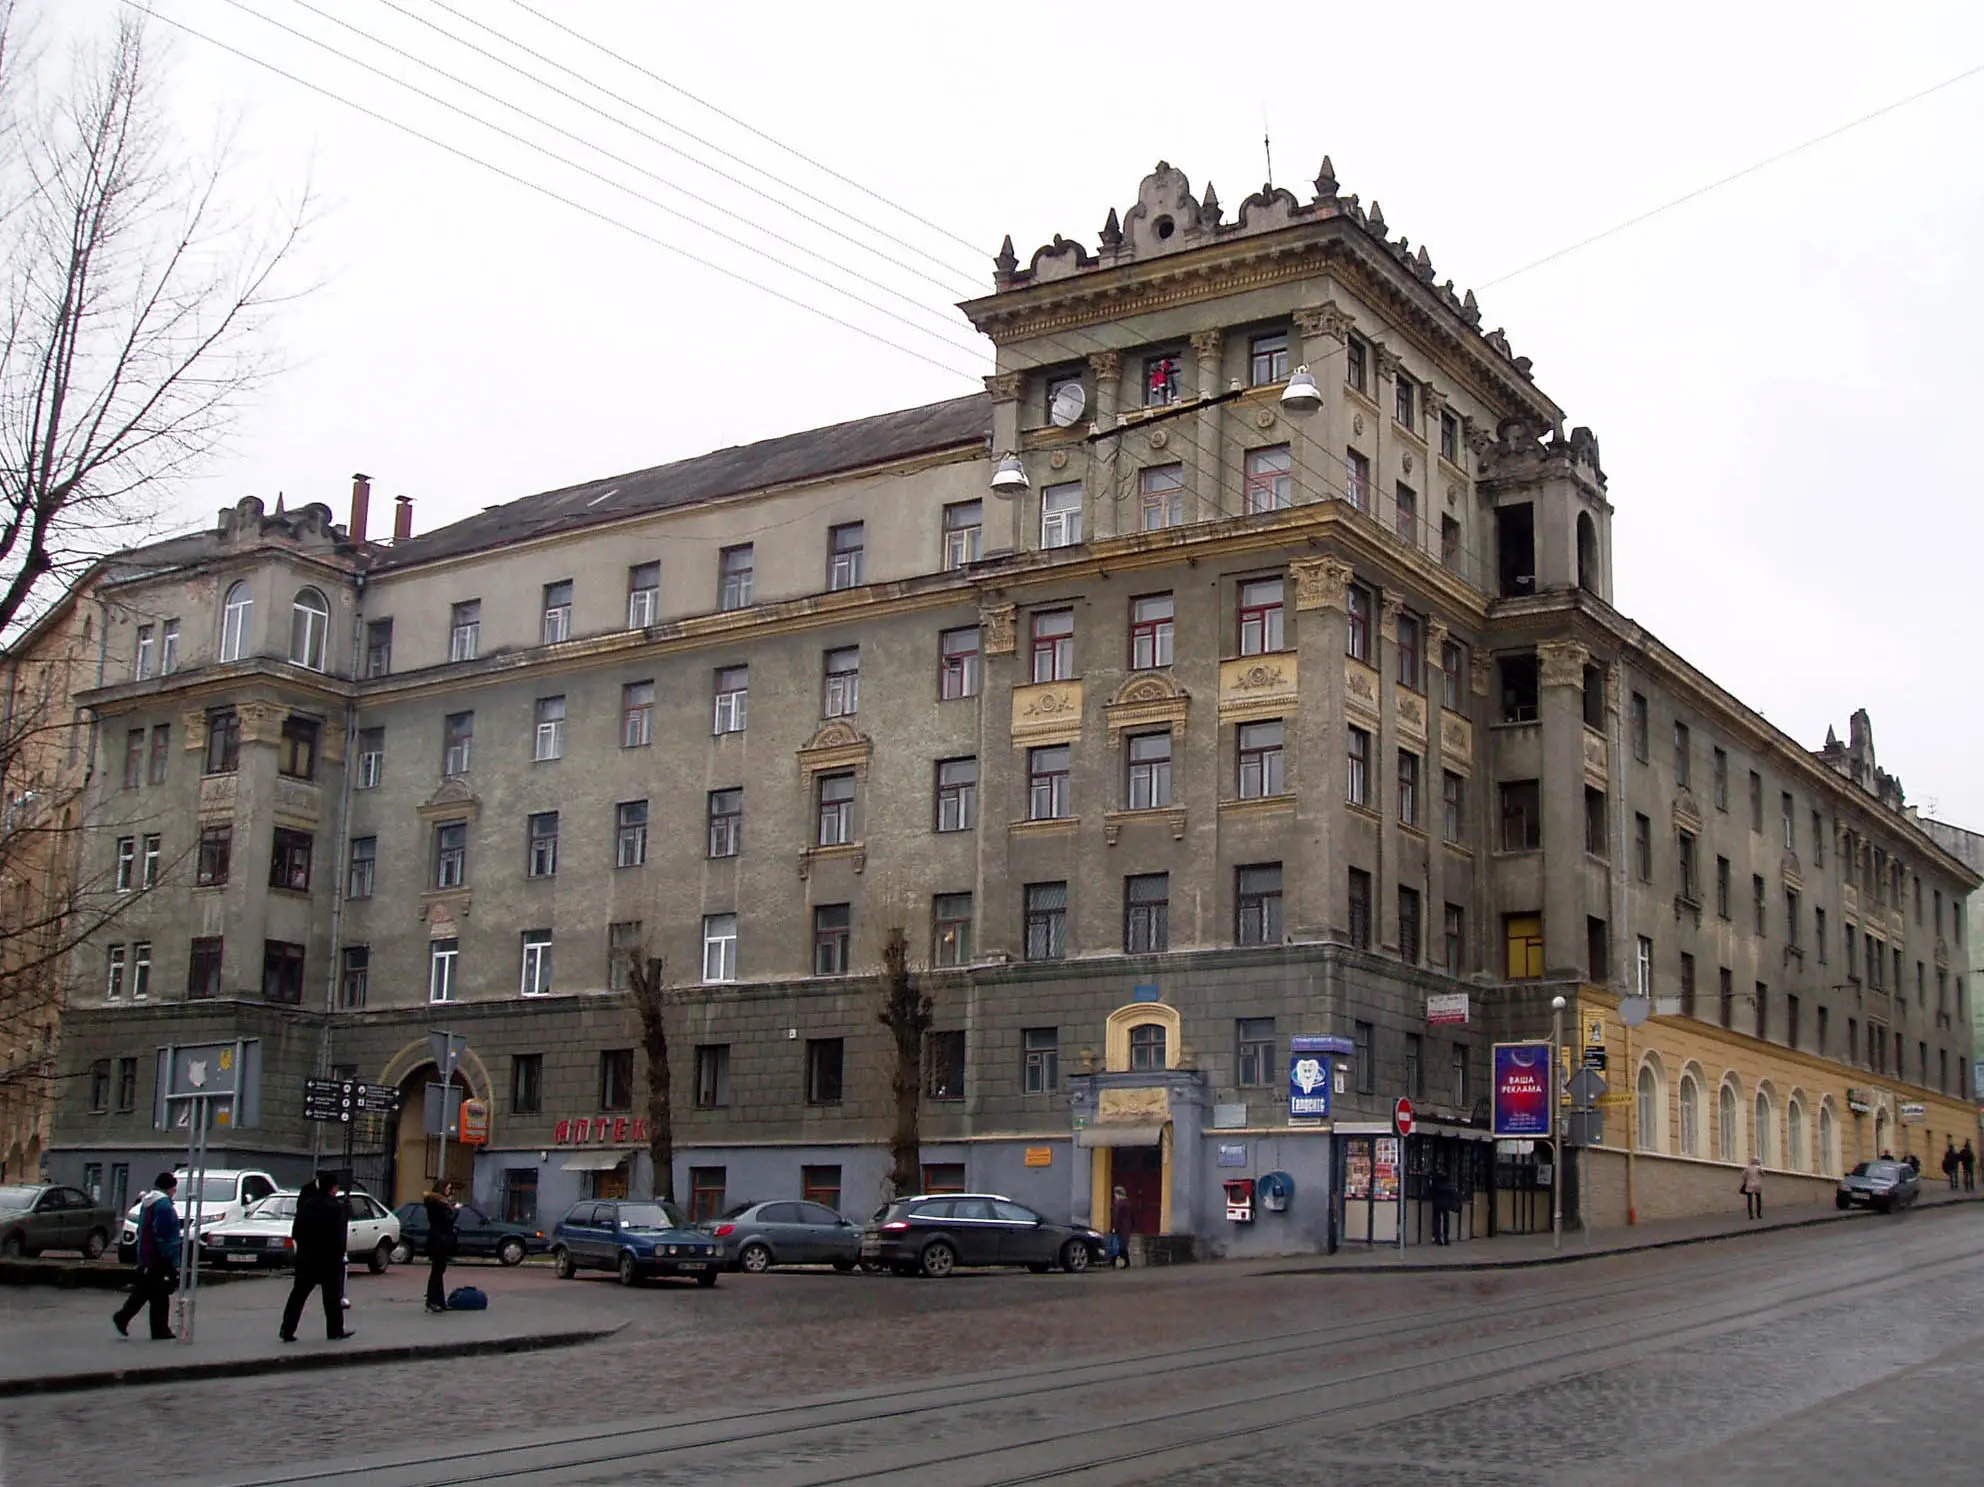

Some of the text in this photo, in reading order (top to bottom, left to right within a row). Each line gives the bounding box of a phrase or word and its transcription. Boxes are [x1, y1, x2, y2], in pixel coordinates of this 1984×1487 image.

[1508, 1076, 1535, 1085] ВАША
[1501, 1085, 1542, 1094] РЕКЛАМА
[553, 1116, 648, 1144] АПТЕК
